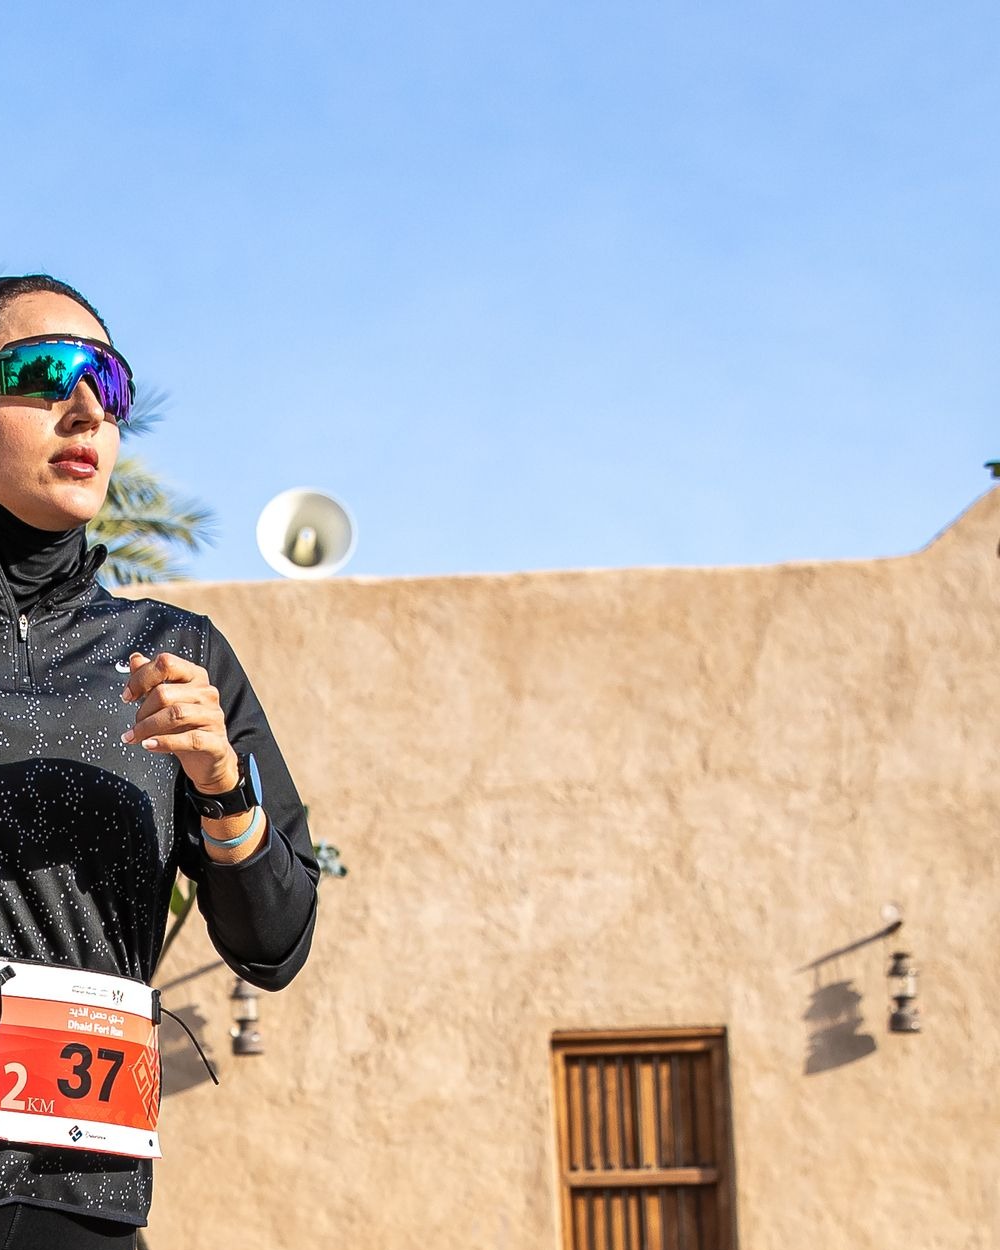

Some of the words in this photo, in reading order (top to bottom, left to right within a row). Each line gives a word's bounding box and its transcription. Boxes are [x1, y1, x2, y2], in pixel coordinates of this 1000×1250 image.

[90, 1010, 107, 1020] حصن
[67, 1020, 92, 1032] Dhaid
[93, 1023, 110, 1035] Fort
[57, 1043, 124, 1102] 37
[27, 1097, 55, 1114] KM
